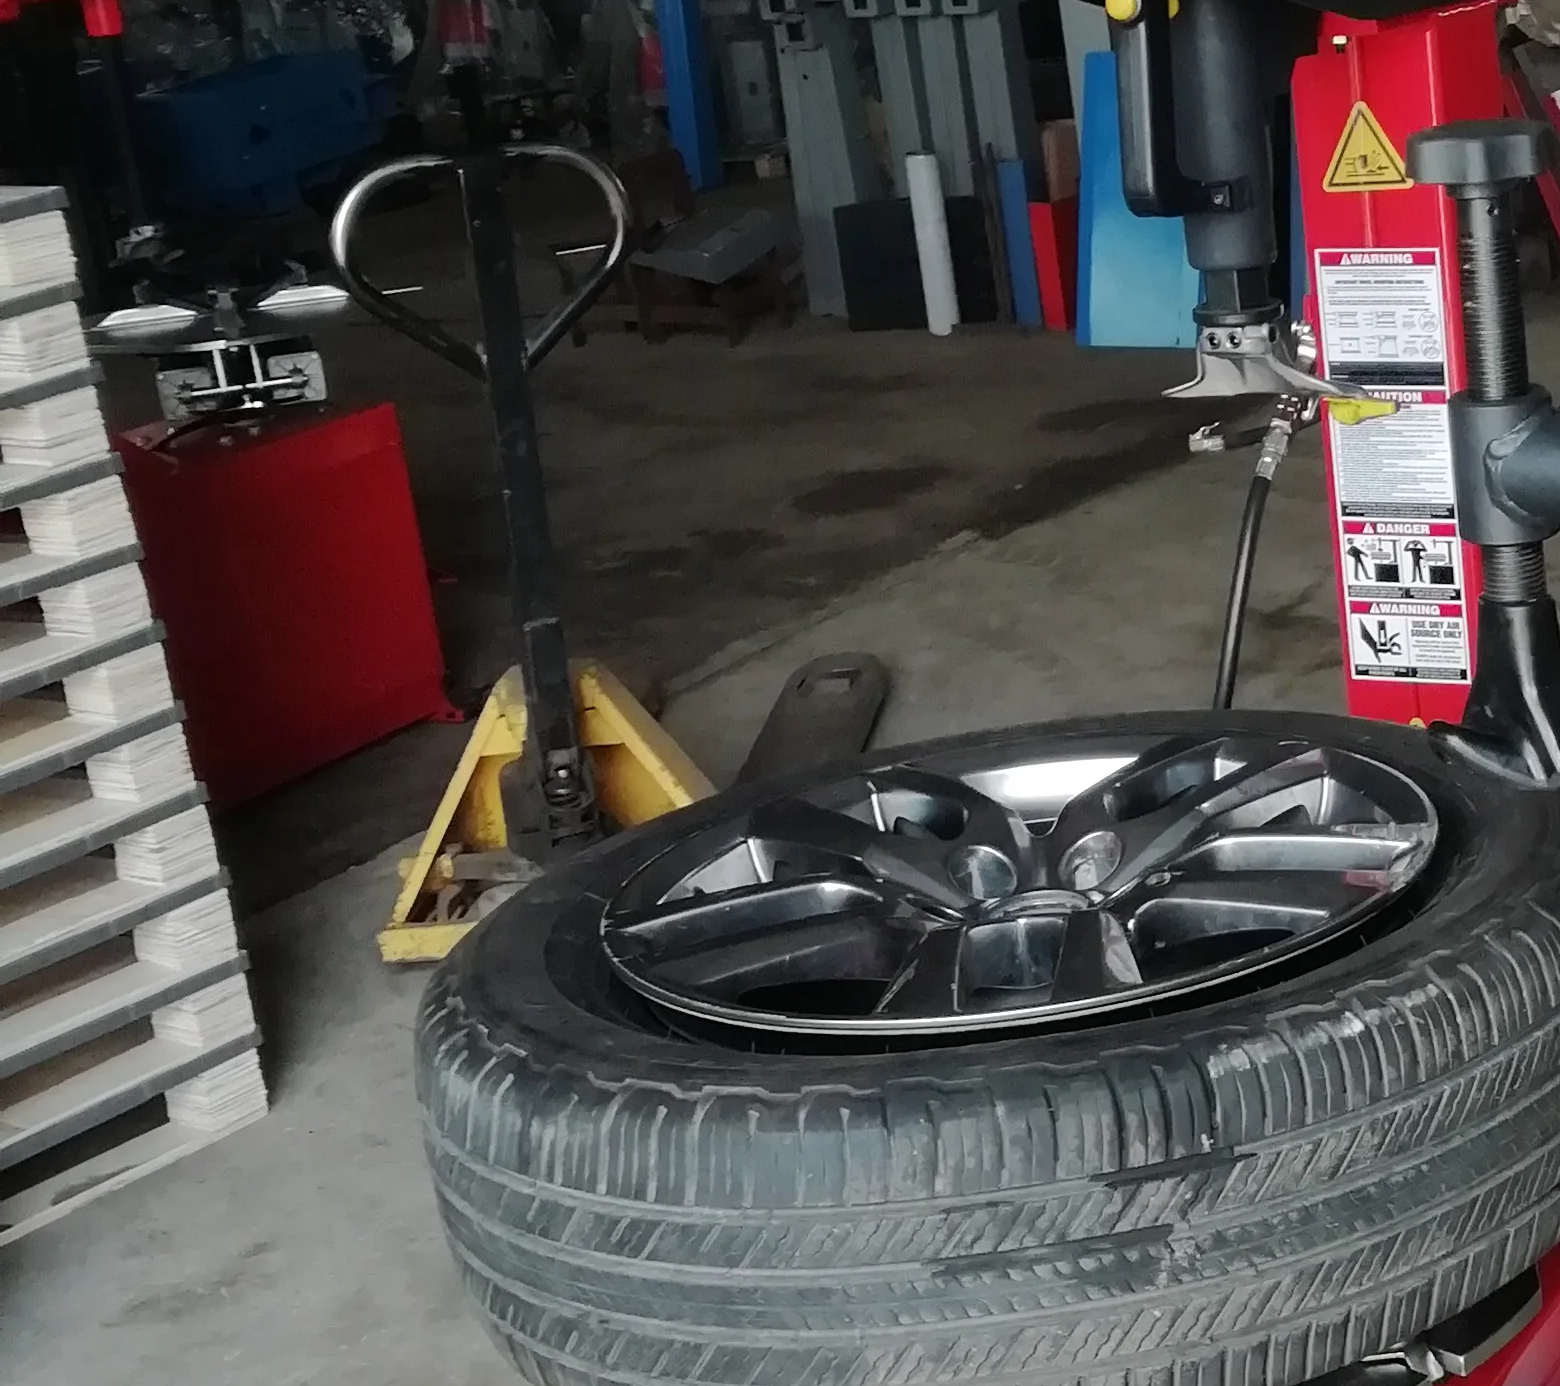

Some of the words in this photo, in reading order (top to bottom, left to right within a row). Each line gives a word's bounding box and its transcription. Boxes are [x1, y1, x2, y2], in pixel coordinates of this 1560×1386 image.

[1349, 253, 1414, 265] WARNING
[1367, 391, 1423, 403] AUTION
[1376, 523, 1431, 535] DANGER
[1379, 604, 1441, 616] WARNING
[1412, 620, 1428, 629] USE
[1429, 621, 1445, 629] DRY
[1447, 621, 1461, 630] AIR
[1411, 629, 1442, 639] SOURCE
[1443, 630, 1463, 639] ONLY
